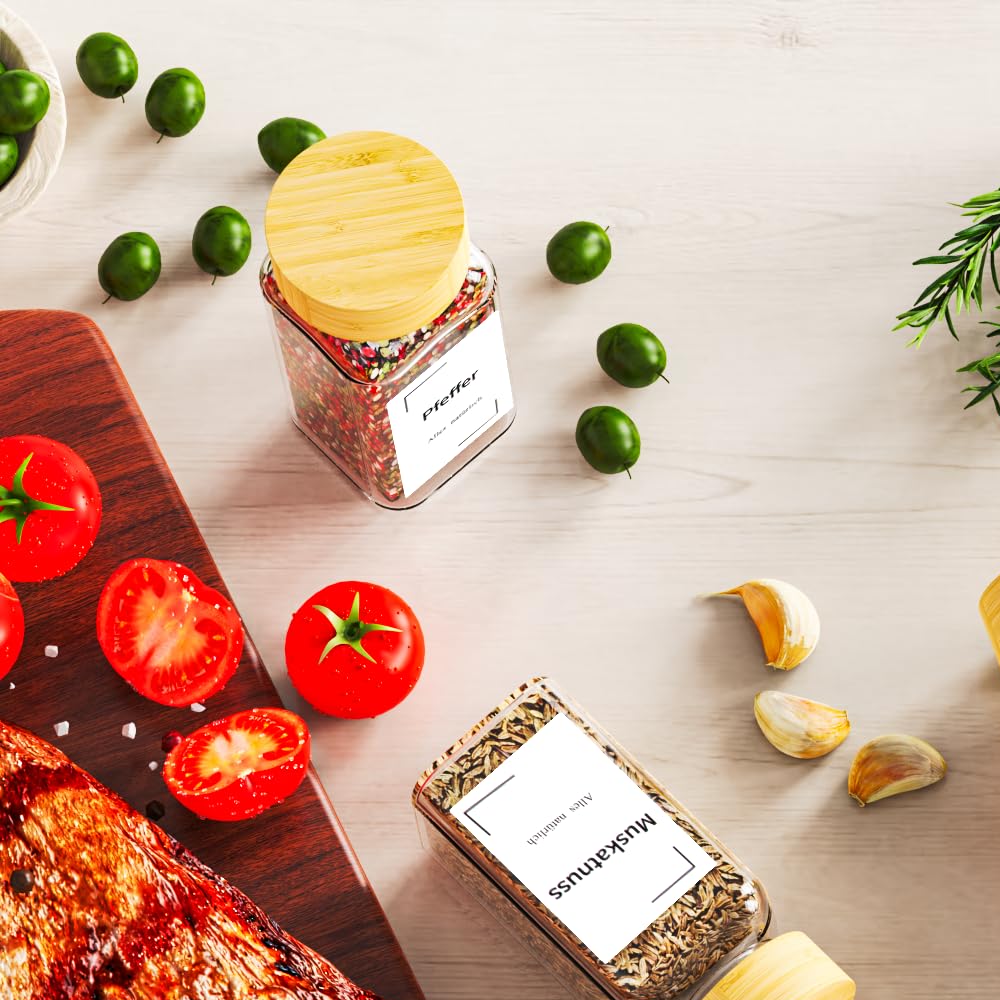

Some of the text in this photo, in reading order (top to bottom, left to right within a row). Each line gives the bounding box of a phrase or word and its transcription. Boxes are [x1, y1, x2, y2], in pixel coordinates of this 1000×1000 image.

[422, 369, 480, 421] Pfeffer
[527, 792, 593, 847] Alles natürlich
[548, 812, 657, 900] Muskatnuss
